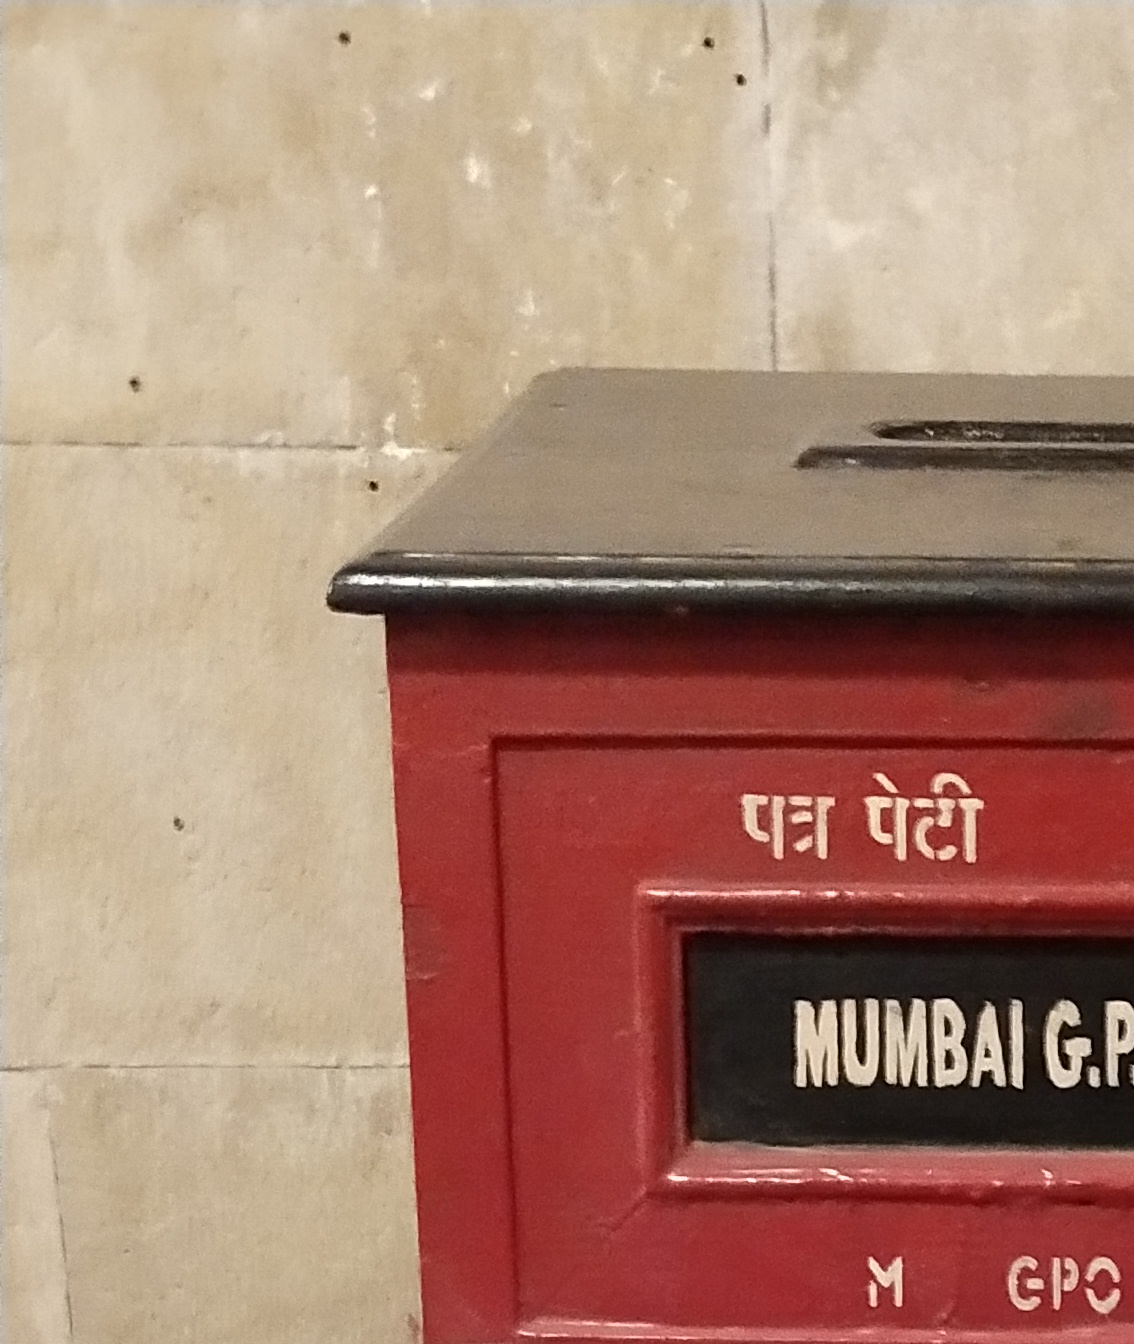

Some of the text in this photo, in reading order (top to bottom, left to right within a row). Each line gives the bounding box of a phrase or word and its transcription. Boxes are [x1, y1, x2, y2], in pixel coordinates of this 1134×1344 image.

[741, 772, 984, 863] पत्र पेटी
[795, 997, 1025, 1089] MUMBAI
[867, 1256, 903, 1308] M
[1007, 1256, 1121, 1314] GPO
